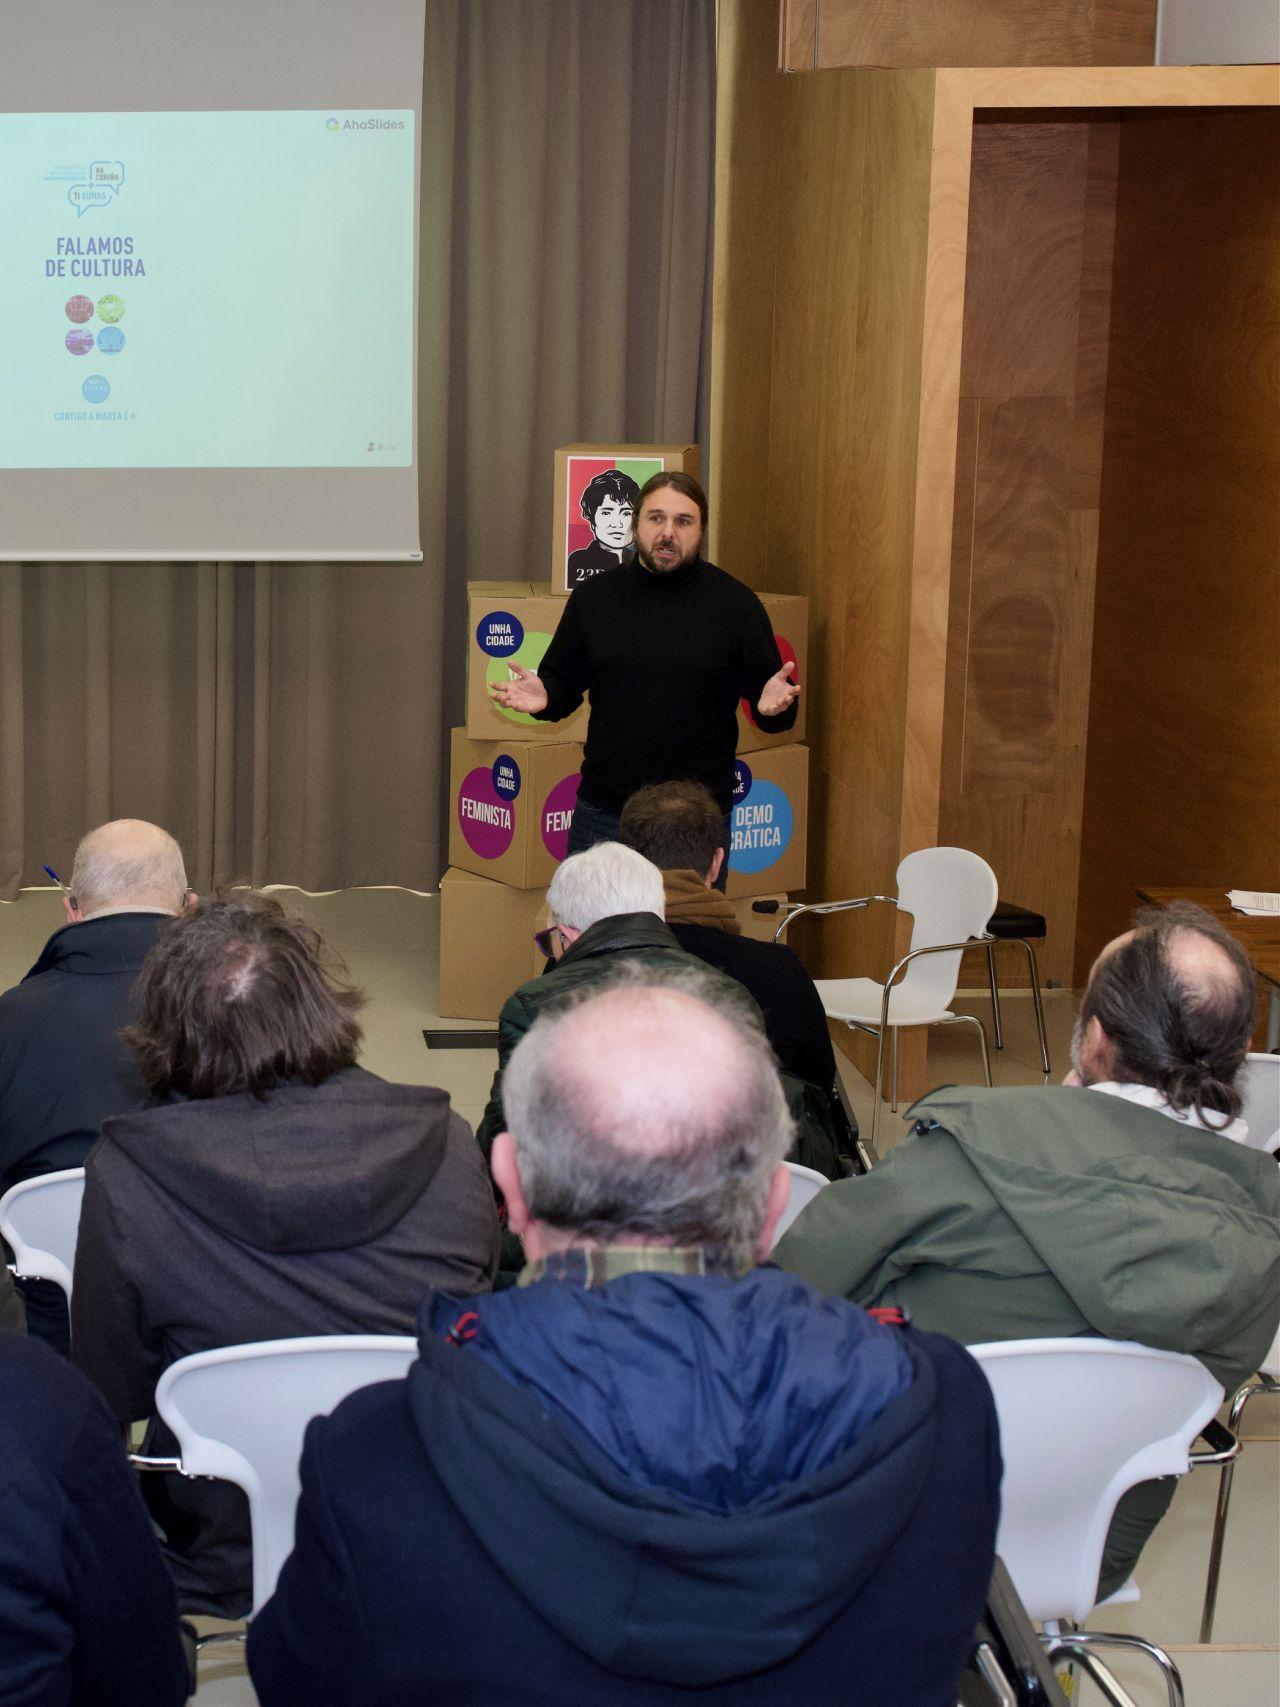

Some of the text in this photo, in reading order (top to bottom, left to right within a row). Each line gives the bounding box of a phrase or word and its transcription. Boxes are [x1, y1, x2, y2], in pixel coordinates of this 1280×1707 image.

[343, 119, 405, 130] AhaSlides
[57, 236, 134, 255] FALAMOS
[46, 258, 146, 277] DE CULTURA
[54, 411, 87, 421] CONTIGO
[89, 412, 95, 421] A
[96, 411, 122, 421] MAREA
[489, 623, 511, 634] UNHA
[485, 635, 515, 646] CIDADE
[499, 765, 514, 779] UNHA
[497, 776, 516, 791] CIDADE
[461, 797, 511, 830] FEMINISTA
[546, 809, 575, 833] FEM
[736, 804, 773, 827] DEMO
